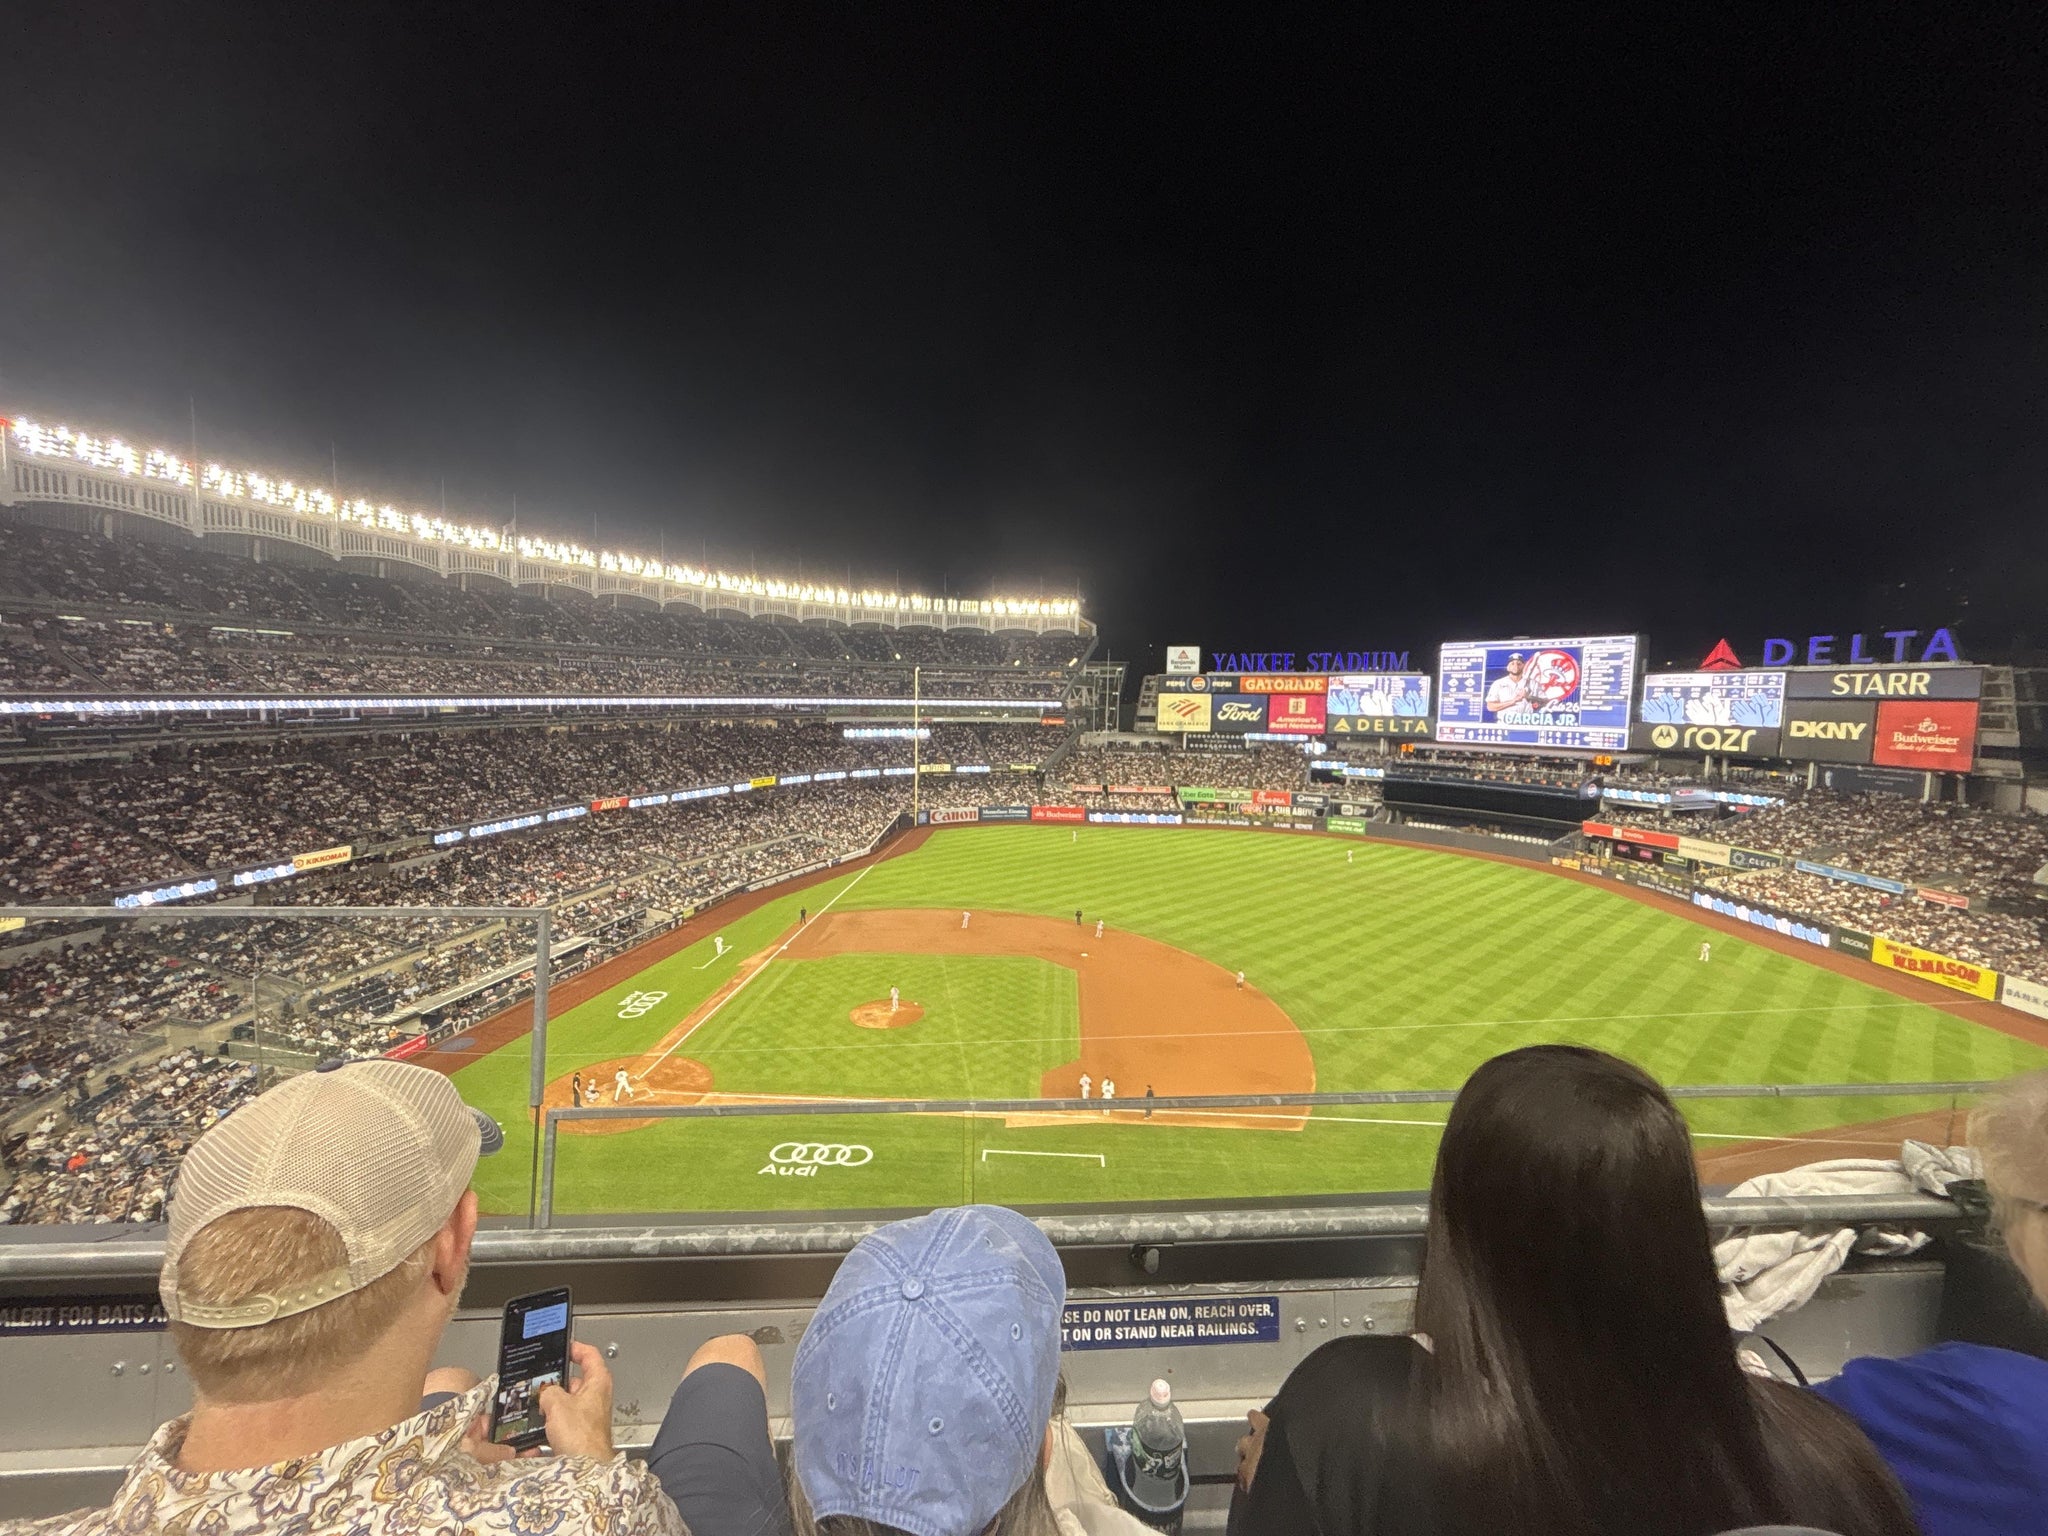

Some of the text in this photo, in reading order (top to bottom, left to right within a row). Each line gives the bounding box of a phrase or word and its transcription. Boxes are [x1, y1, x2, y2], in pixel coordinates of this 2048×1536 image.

[1763, 628, 1958, 666] DELTA
[1212, 650, 1409, 672] YANKEE STADIUM
[1245, 677, 1323, 691] GATORADE
[1831, 672, 1931, 695] STARR
[1217, 702, 1262, 722] Ford
[1565, 702, 1580, 713] 26
[1357, 719, 1428, 733] DELTA
[1556, 714, 1578, 727] JR.
[1790, 721, 1867, 740] DKNY
[1683, 726, 1757, 752] razr
[1893, 731, 1960, 746] Budweiser
[600, 799, 621, 810] AVIS
[931, 809, 977, 822] Canon
[1046, 811, 1082, 819] Budweiser
[306, 852, 348, 865] KIKKOMAN
[757, 1163, 818, 1177] Audi
[58, 1305, 93, 1326] FOR
[98, 1304, 144, 1325] BATS
[1083, 1310, 1101, 1323] DO
[1104, 1309, 1131, 1322] NOT
[1134, 1307, 1166, 1321] LEAN
[1170, 1306, 1191, 1320] ON,
[1194, 1304, 1235, 1318] REACH
[1239, 1303, 1275, 1317] OVER,
[1072, 1327, 1091, 1341] ON
[1094, 1327, 1112, 1340] OR
[1115, 1325, 1157, 1339] STAND
[1161, 1323, 1194, 1337] NEAR
[1197, 1321, 1259, 1336] RAILINGS.
